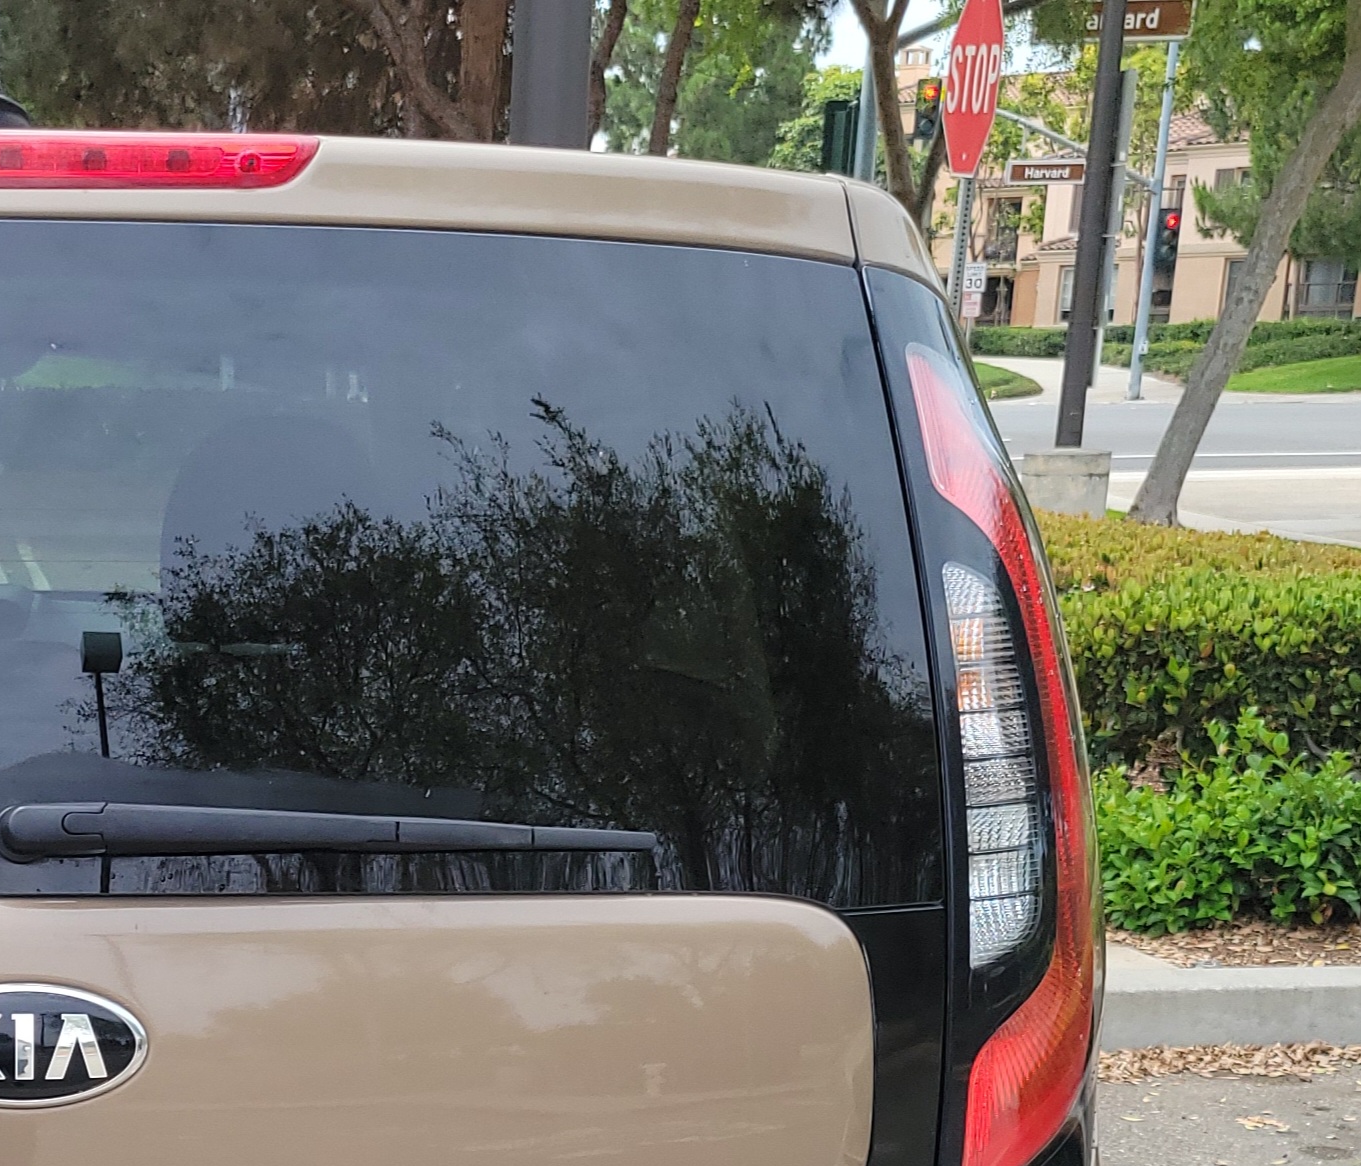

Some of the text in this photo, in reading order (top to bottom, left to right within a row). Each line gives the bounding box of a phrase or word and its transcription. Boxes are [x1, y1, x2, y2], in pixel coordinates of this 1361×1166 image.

[946, 43, 1000, 114] STOP
[1024, 166, 1070, 179] Harvard
[965, 278, 982, 289] 30
